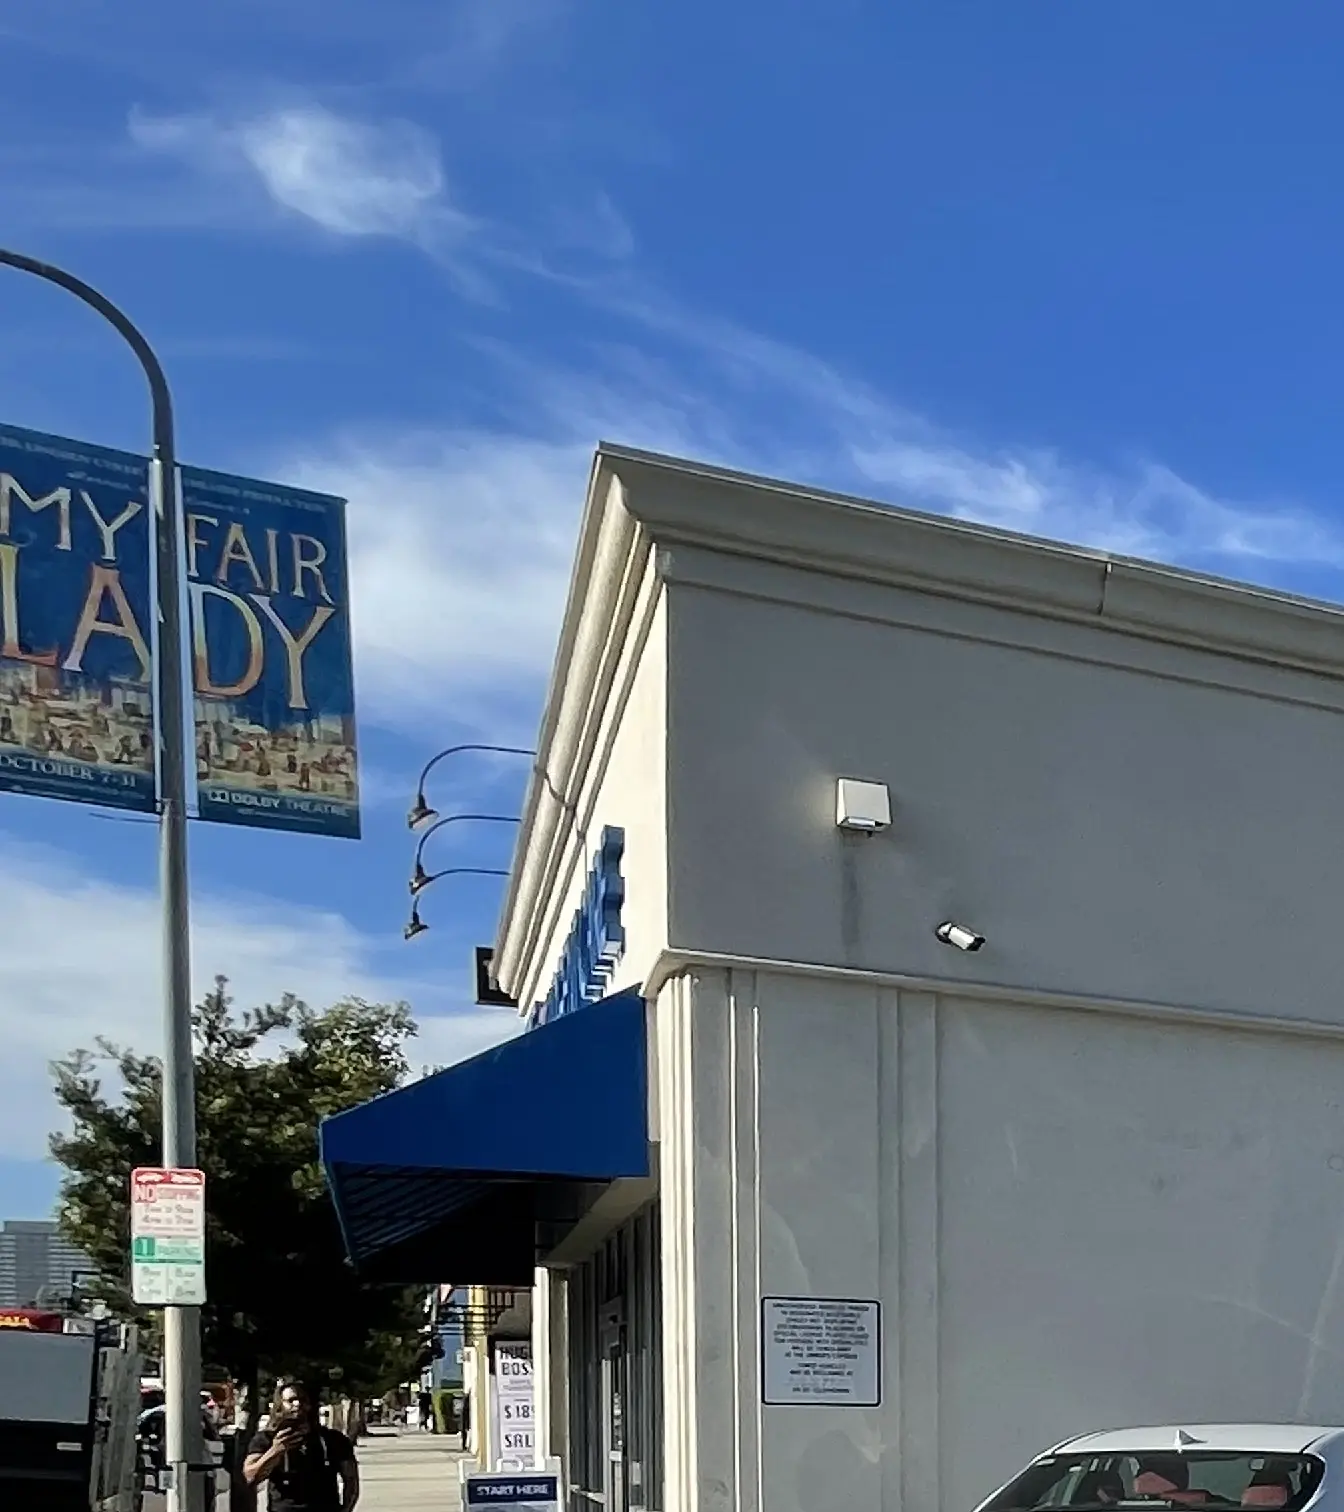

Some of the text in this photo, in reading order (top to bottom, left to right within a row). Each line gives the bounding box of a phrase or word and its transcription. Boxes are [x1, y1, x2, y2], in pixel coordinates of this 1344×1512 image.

[0, 473, 143, 560] MY
[187, 514, 335, 605] FAIR
[500, 1346, 534, 1360] HUG
[504, 1433, 534, 1448] SAL
[477, 1484, 549, 1496] START HERE
